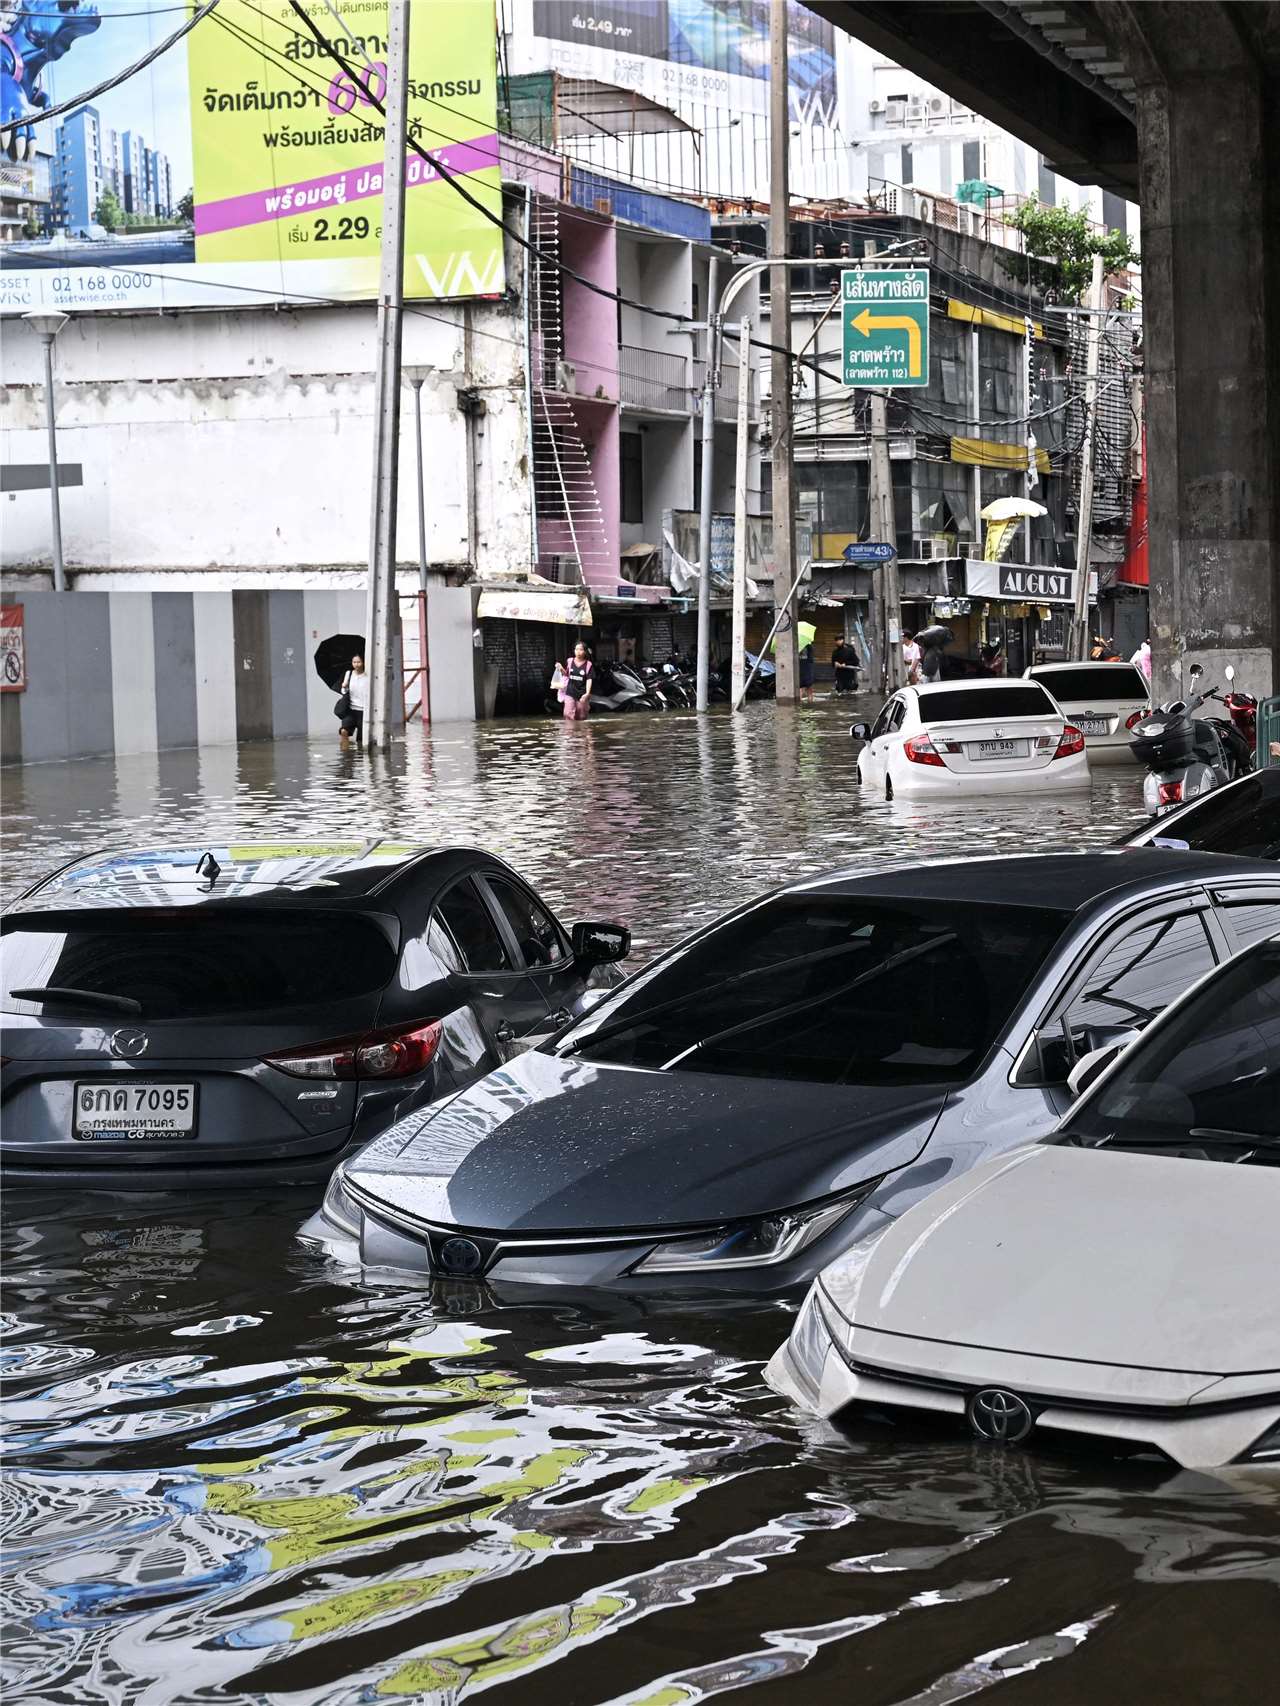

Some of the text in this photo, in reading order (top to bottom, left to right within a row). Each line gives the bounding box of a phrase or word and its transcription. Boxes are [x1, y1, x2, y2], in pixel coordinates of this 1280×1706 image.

[203, 81, 320, 112] จัดเต็มกว่า
[327, 61, 388, 116] 60
[265, 176, 346, 213] พร้อมอยู่
[288, 225, 308, 243] เริ่ม
[314, 216, 370, 242] 2.29
[52, 273, 152, 292] 02 168 0000
[846, 273, 925, 298] เส้นทางลัด
[54, 291, 128, 304] assetwise.co.th
[849, 345, 905, 364] ลาดพร้าว
[845, 367, 908, 379] (ลาดพร้าว 112)
[1003, 571, 1068, 596] AUGUST
[81, 1089, 190, 1112] 6กด 7095
[93, 1118, 176, 1131] กรุงเทพมหานคร
[94, 1131, 125, 1139] mazda
[128, 1129, 146, 1139] CG
